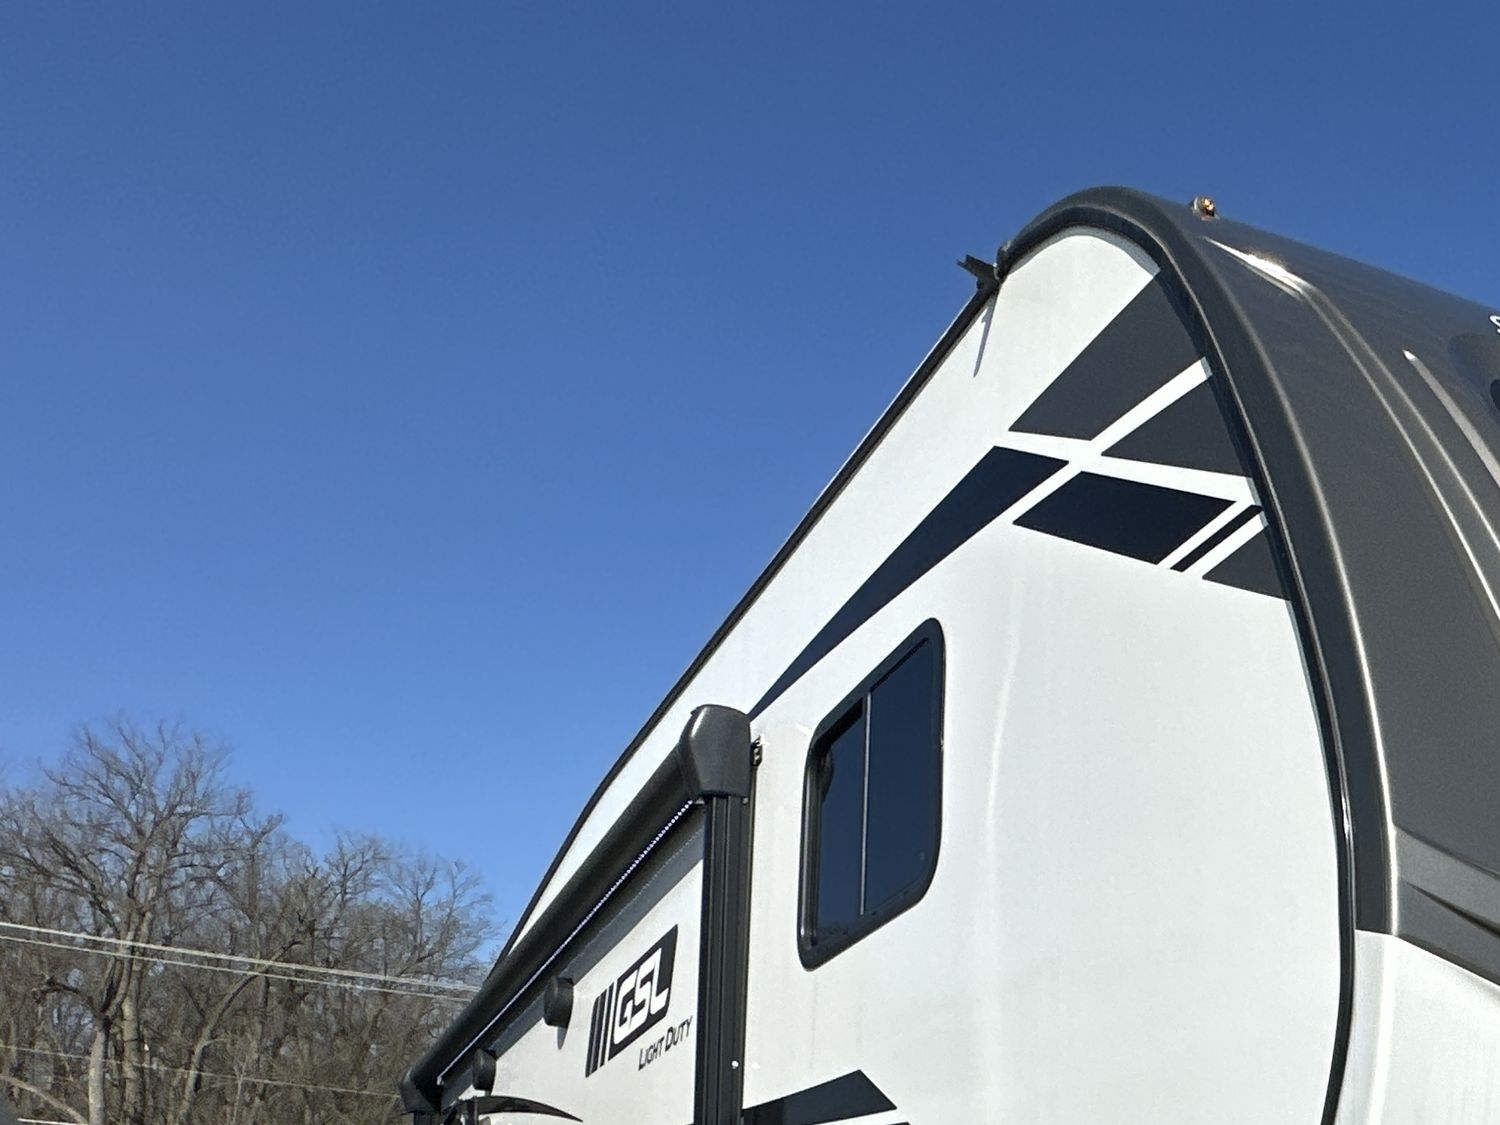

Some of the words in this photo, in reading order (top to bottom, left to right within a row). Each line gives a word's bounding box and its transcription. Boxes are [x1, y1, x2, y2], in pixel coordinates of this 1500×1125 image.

[613, 947, 669, 1045] GSL
[638, 1036, 664, 1071] LIGHT
[665, 1016, 693, 1053] DUTY
